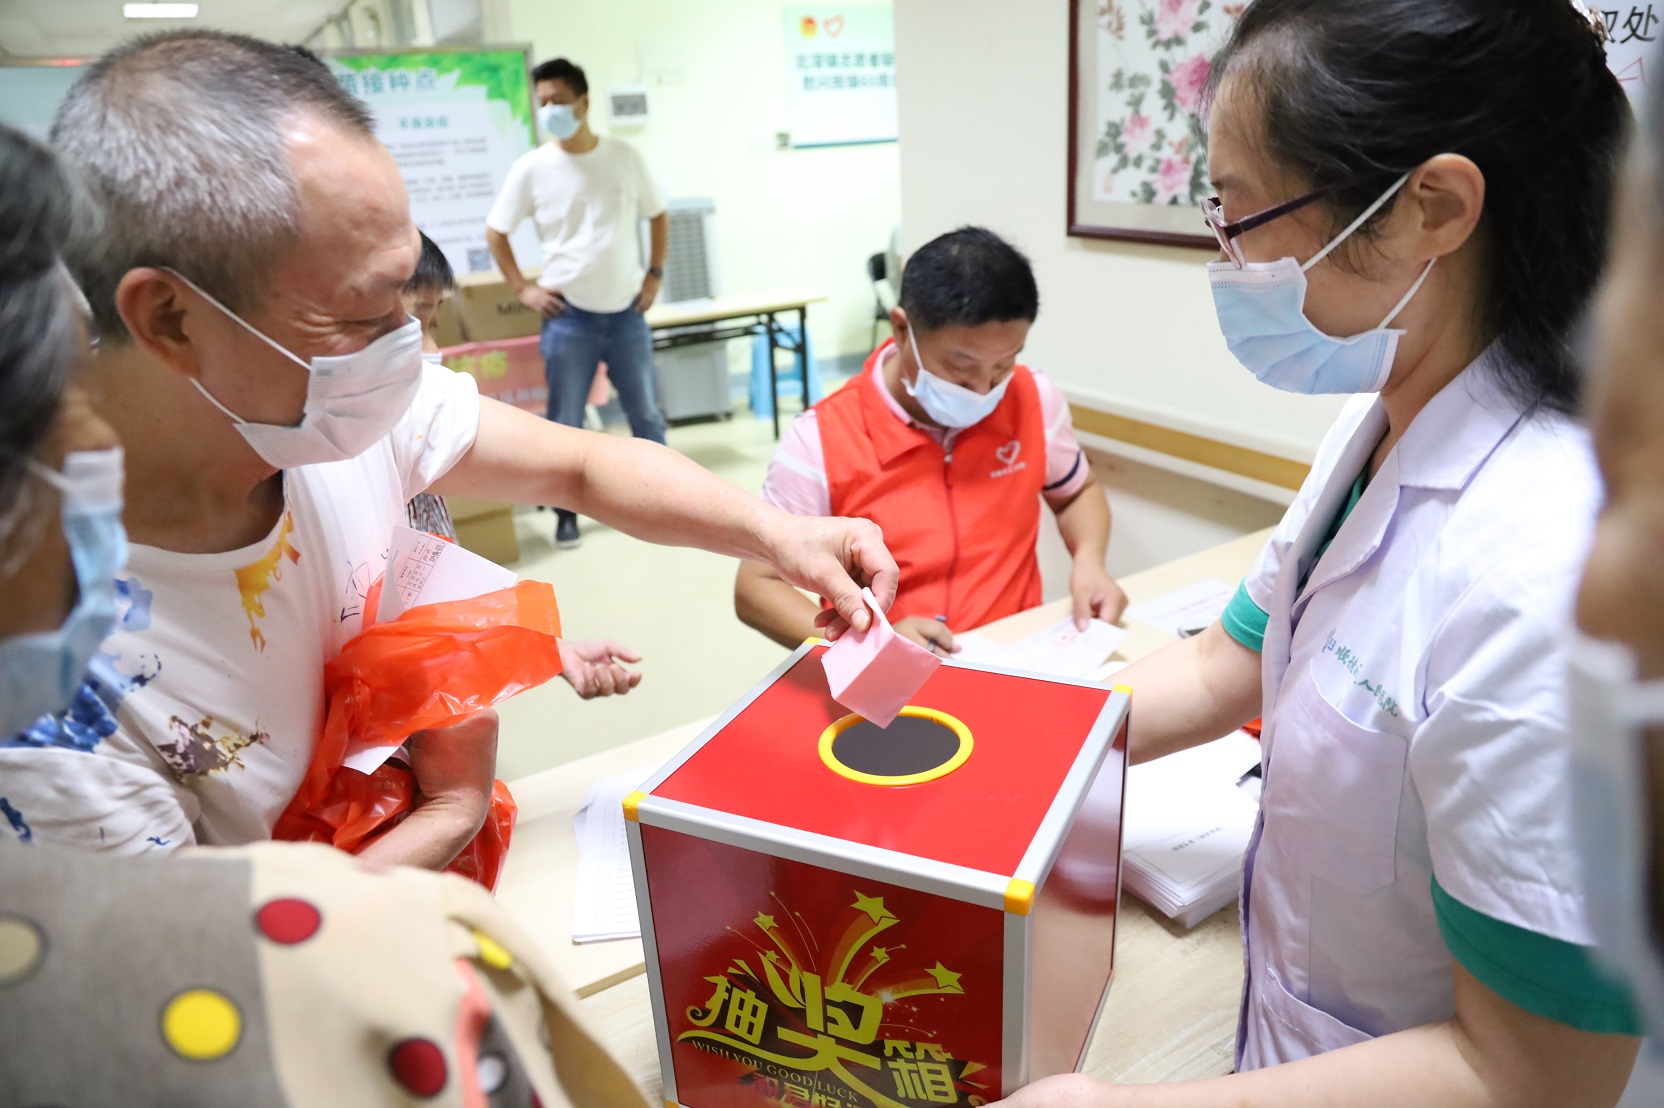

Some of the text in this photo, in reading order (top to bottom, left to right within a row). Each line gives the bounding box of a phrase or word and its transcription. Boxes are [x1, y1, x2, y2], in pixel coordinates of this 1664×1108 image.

[677, 951, 958, 1106] 抽奖箱
[691, 1039, 859, 1103] WISH YOU GOOD LUCK
[753, 1071, 868, 1108] 祝君好
